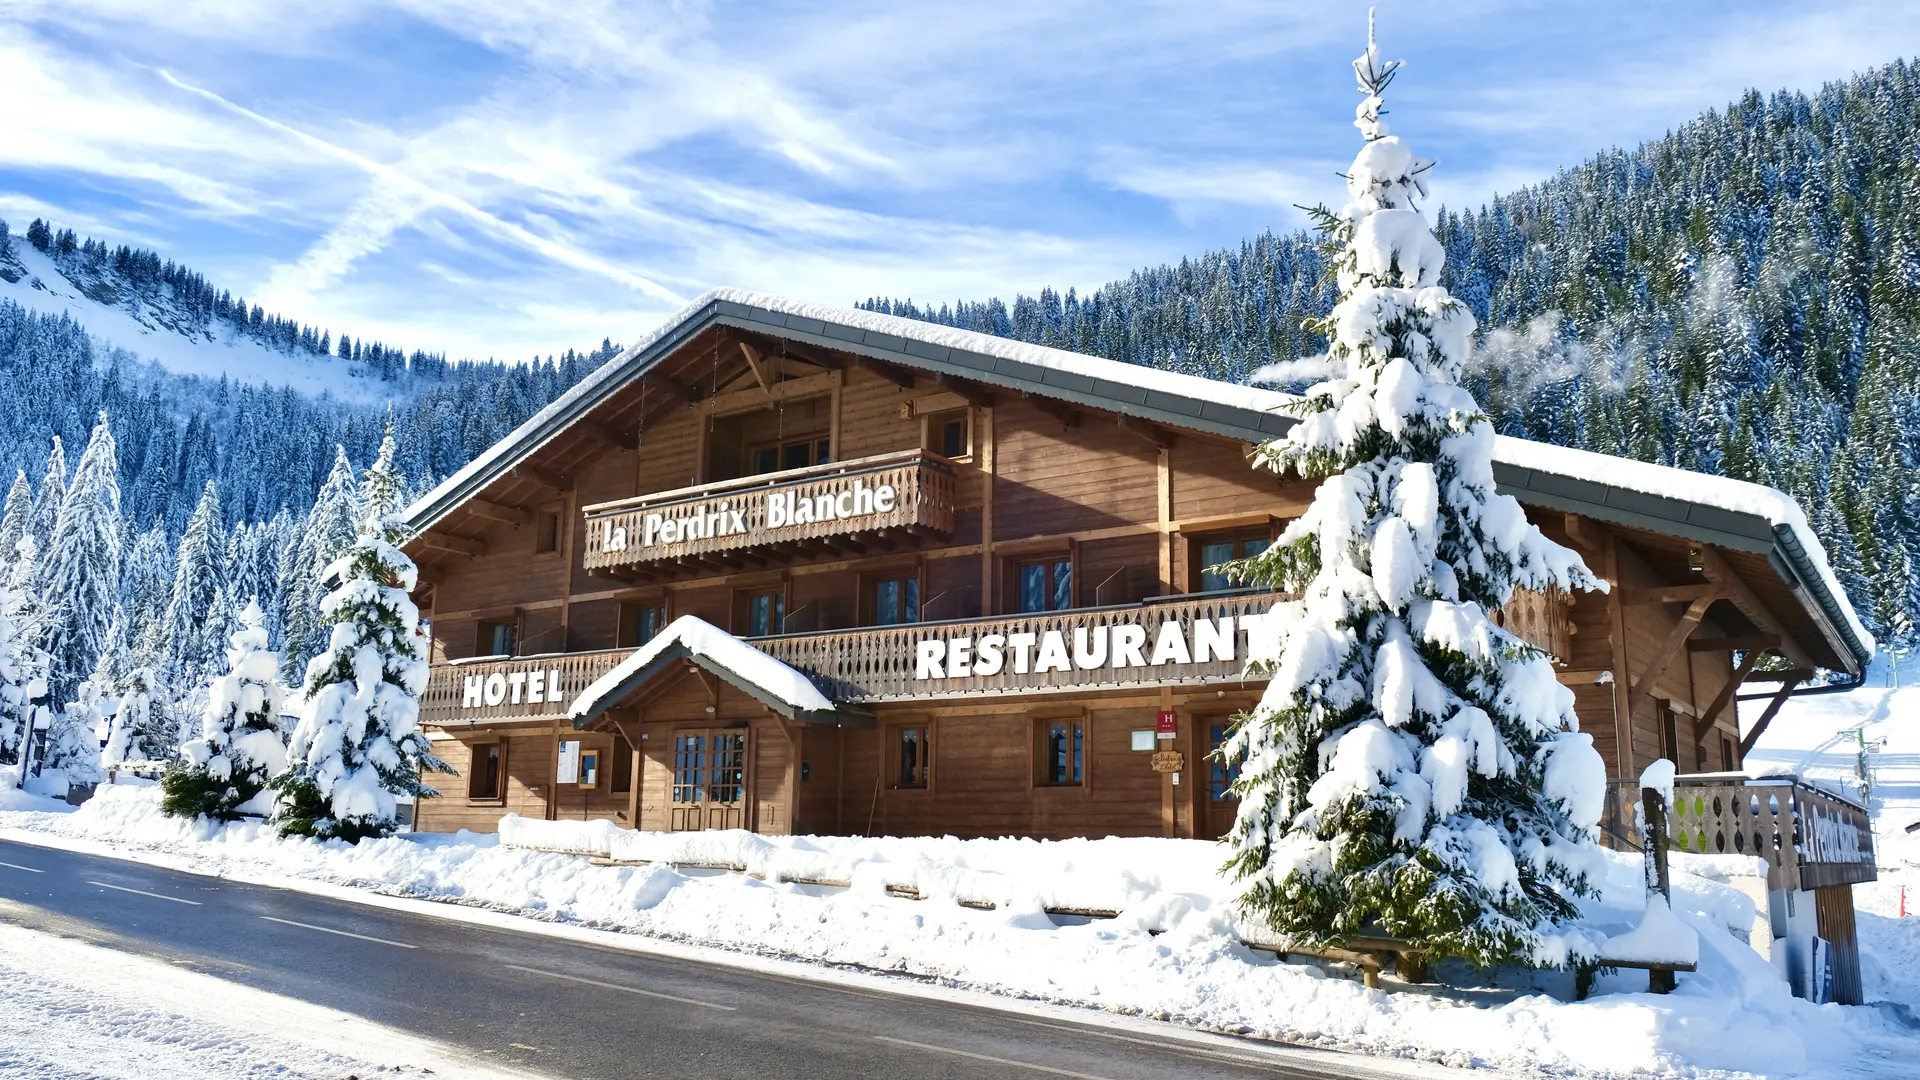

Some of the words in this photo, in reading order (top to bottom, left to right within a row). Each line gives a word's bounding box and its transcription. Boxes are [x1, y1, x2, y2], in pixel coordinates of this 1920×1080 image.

[644, 501, 748, 547] Perdrix
[767, 479, 896, 529] Blanche
[462, 669, 564, 709] HOTEL
[1164, 714, 1173, 723] H
